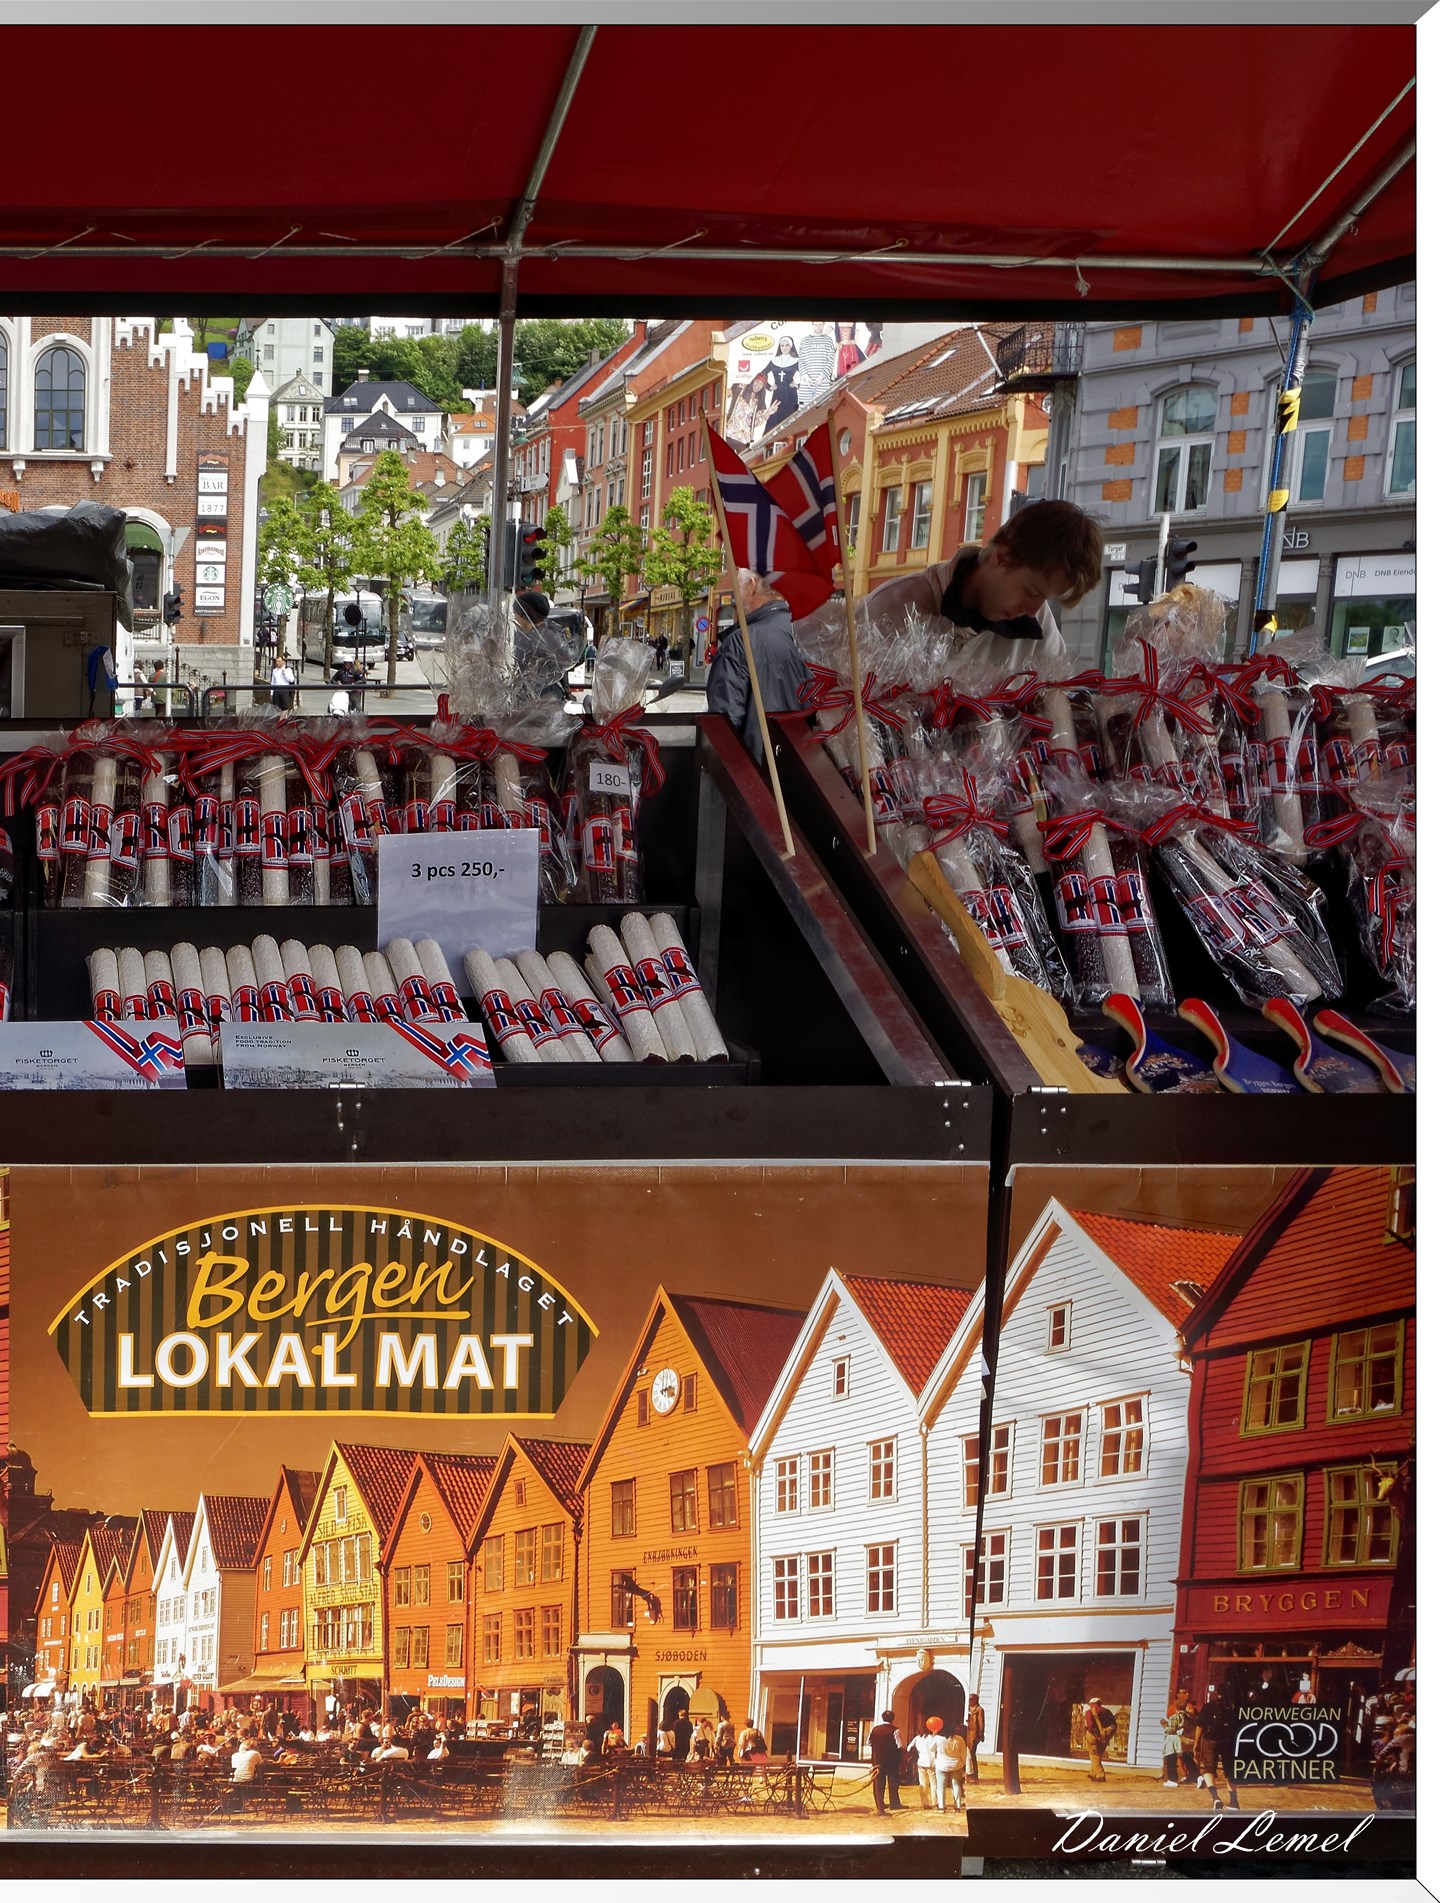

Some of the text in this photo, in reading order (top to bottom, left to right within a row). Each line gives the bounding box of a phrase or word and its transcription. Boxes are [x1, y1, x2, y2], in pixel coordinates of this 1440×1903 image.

[1283, 526, 1309, 549] NB
[1375, 569, 1392, 577] DNB
[596, 772, 626, 788] 180-
[411, 861, 506, 881] 3 pcs 250,-
[74, 1218, 574, 1330] TRADISJONELL HÅNDLAGET
[186, 1252, 475, 1355] Bergen
[117, 1331, 535, 1390] LOKAL MAT
[1213, 1588, 1372, 1614] BRYGGEN
[655, 1651, 708, 1662] SJØBODEN
[1237, 1706, 1342, 1722] NORWEGIAN
[1234, 1722, 1339, 1758] FOOD
[1233, 1759, 1337, 1780] PARTNER
